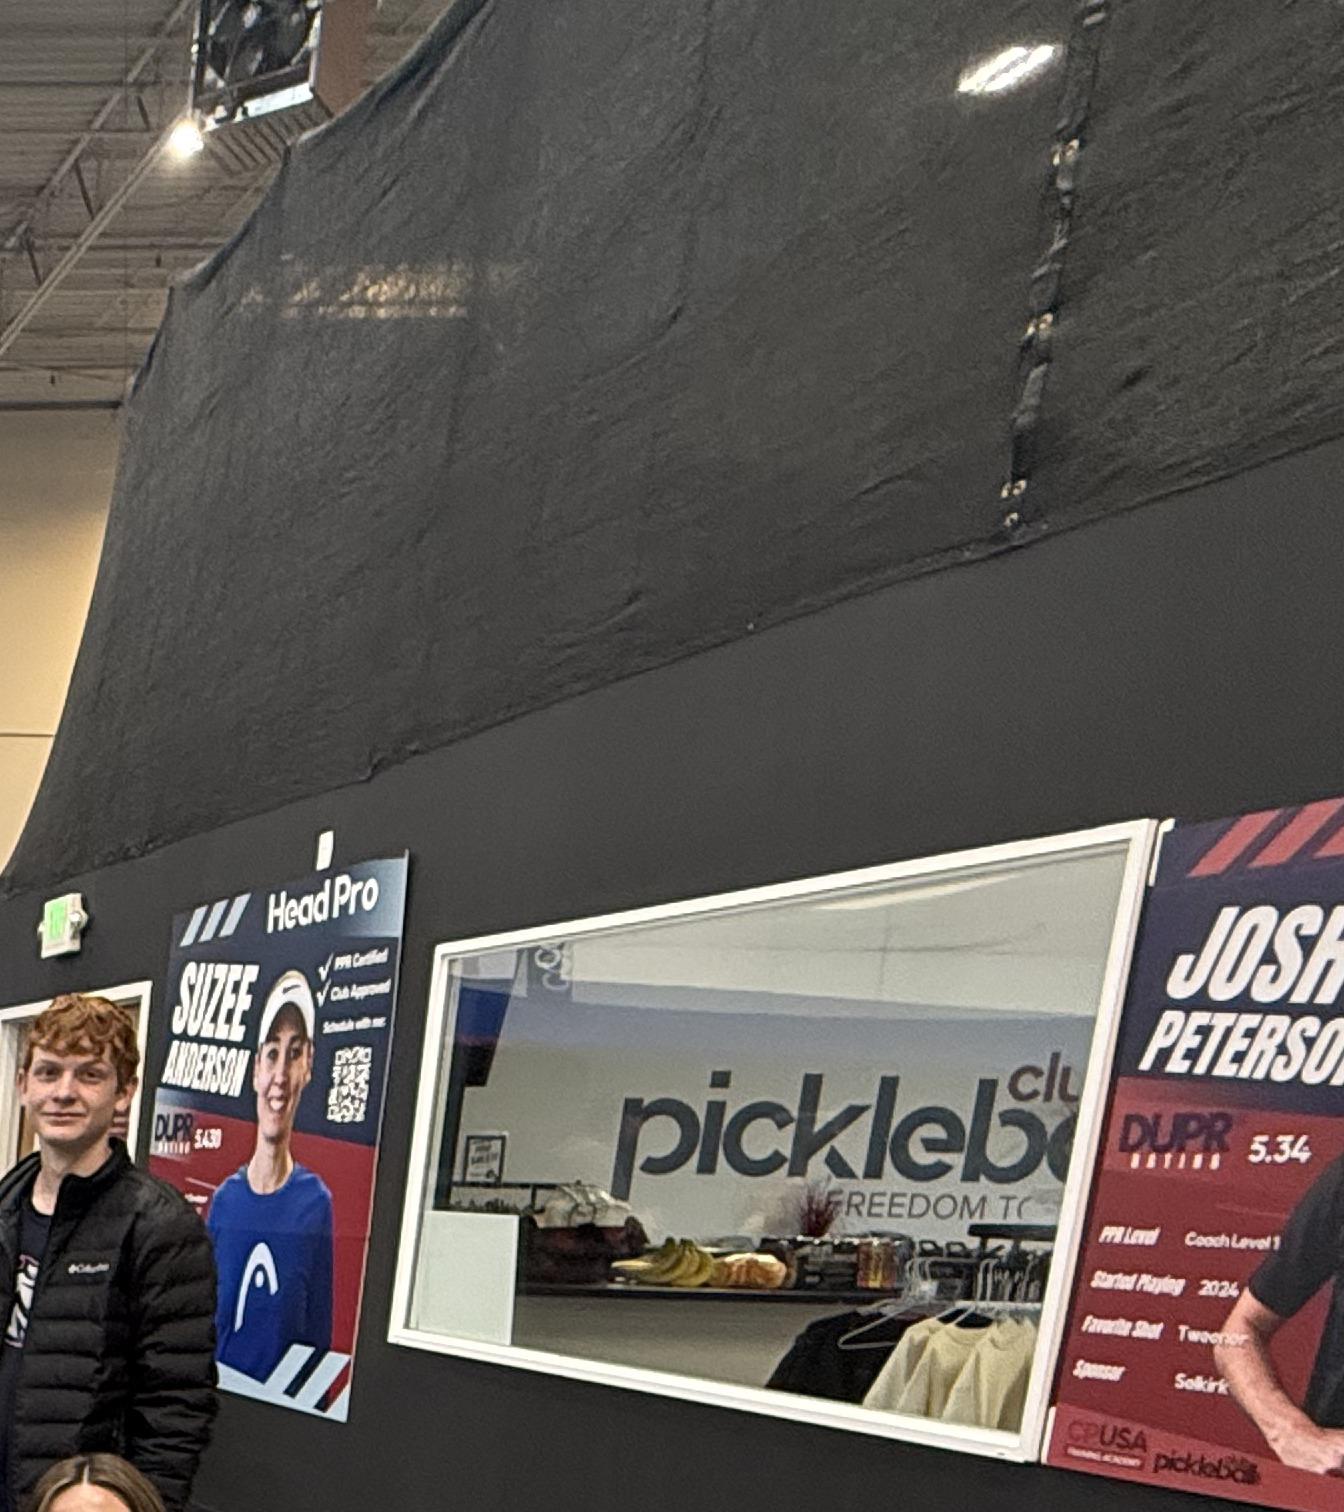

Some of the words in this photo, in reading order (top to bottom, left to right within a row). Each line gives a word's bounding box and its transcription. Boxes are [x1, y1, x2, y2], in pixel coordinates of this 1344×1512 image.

[267, 879, 331, 933] Head
[333, 874, 380, 918] Pro
[172, 961, 260, 1042] SUZEE
[1138, 1009, 1344, 1087] PETERSO
[161, 1040, 251, 1097] ANDERSON
[154, 1113, 193, 1142] DUPR
[1118, 1112, 1233, 1153] DUPR
[1248, 1134, 1312, 1164] 5.34
[1123, 1227, 1161, 1246] Level
[1185, 1231, 1230, 1249] Coach
[1231, 1233, 1272, 1250] Level
[1090, 1270, 1138, 1291] Started
[1136, 1273, 1186, 1296] Playing
[1198, 1279, 1240, 1298] 2024
[1081, 1315, 1134, 1336] Favorite
[1131, 1320, 1165, 1340] Shot
[1073, 1359, 1127, 1382] Sponsor
[1174, 1373, 1231, 1396] Selkirk
